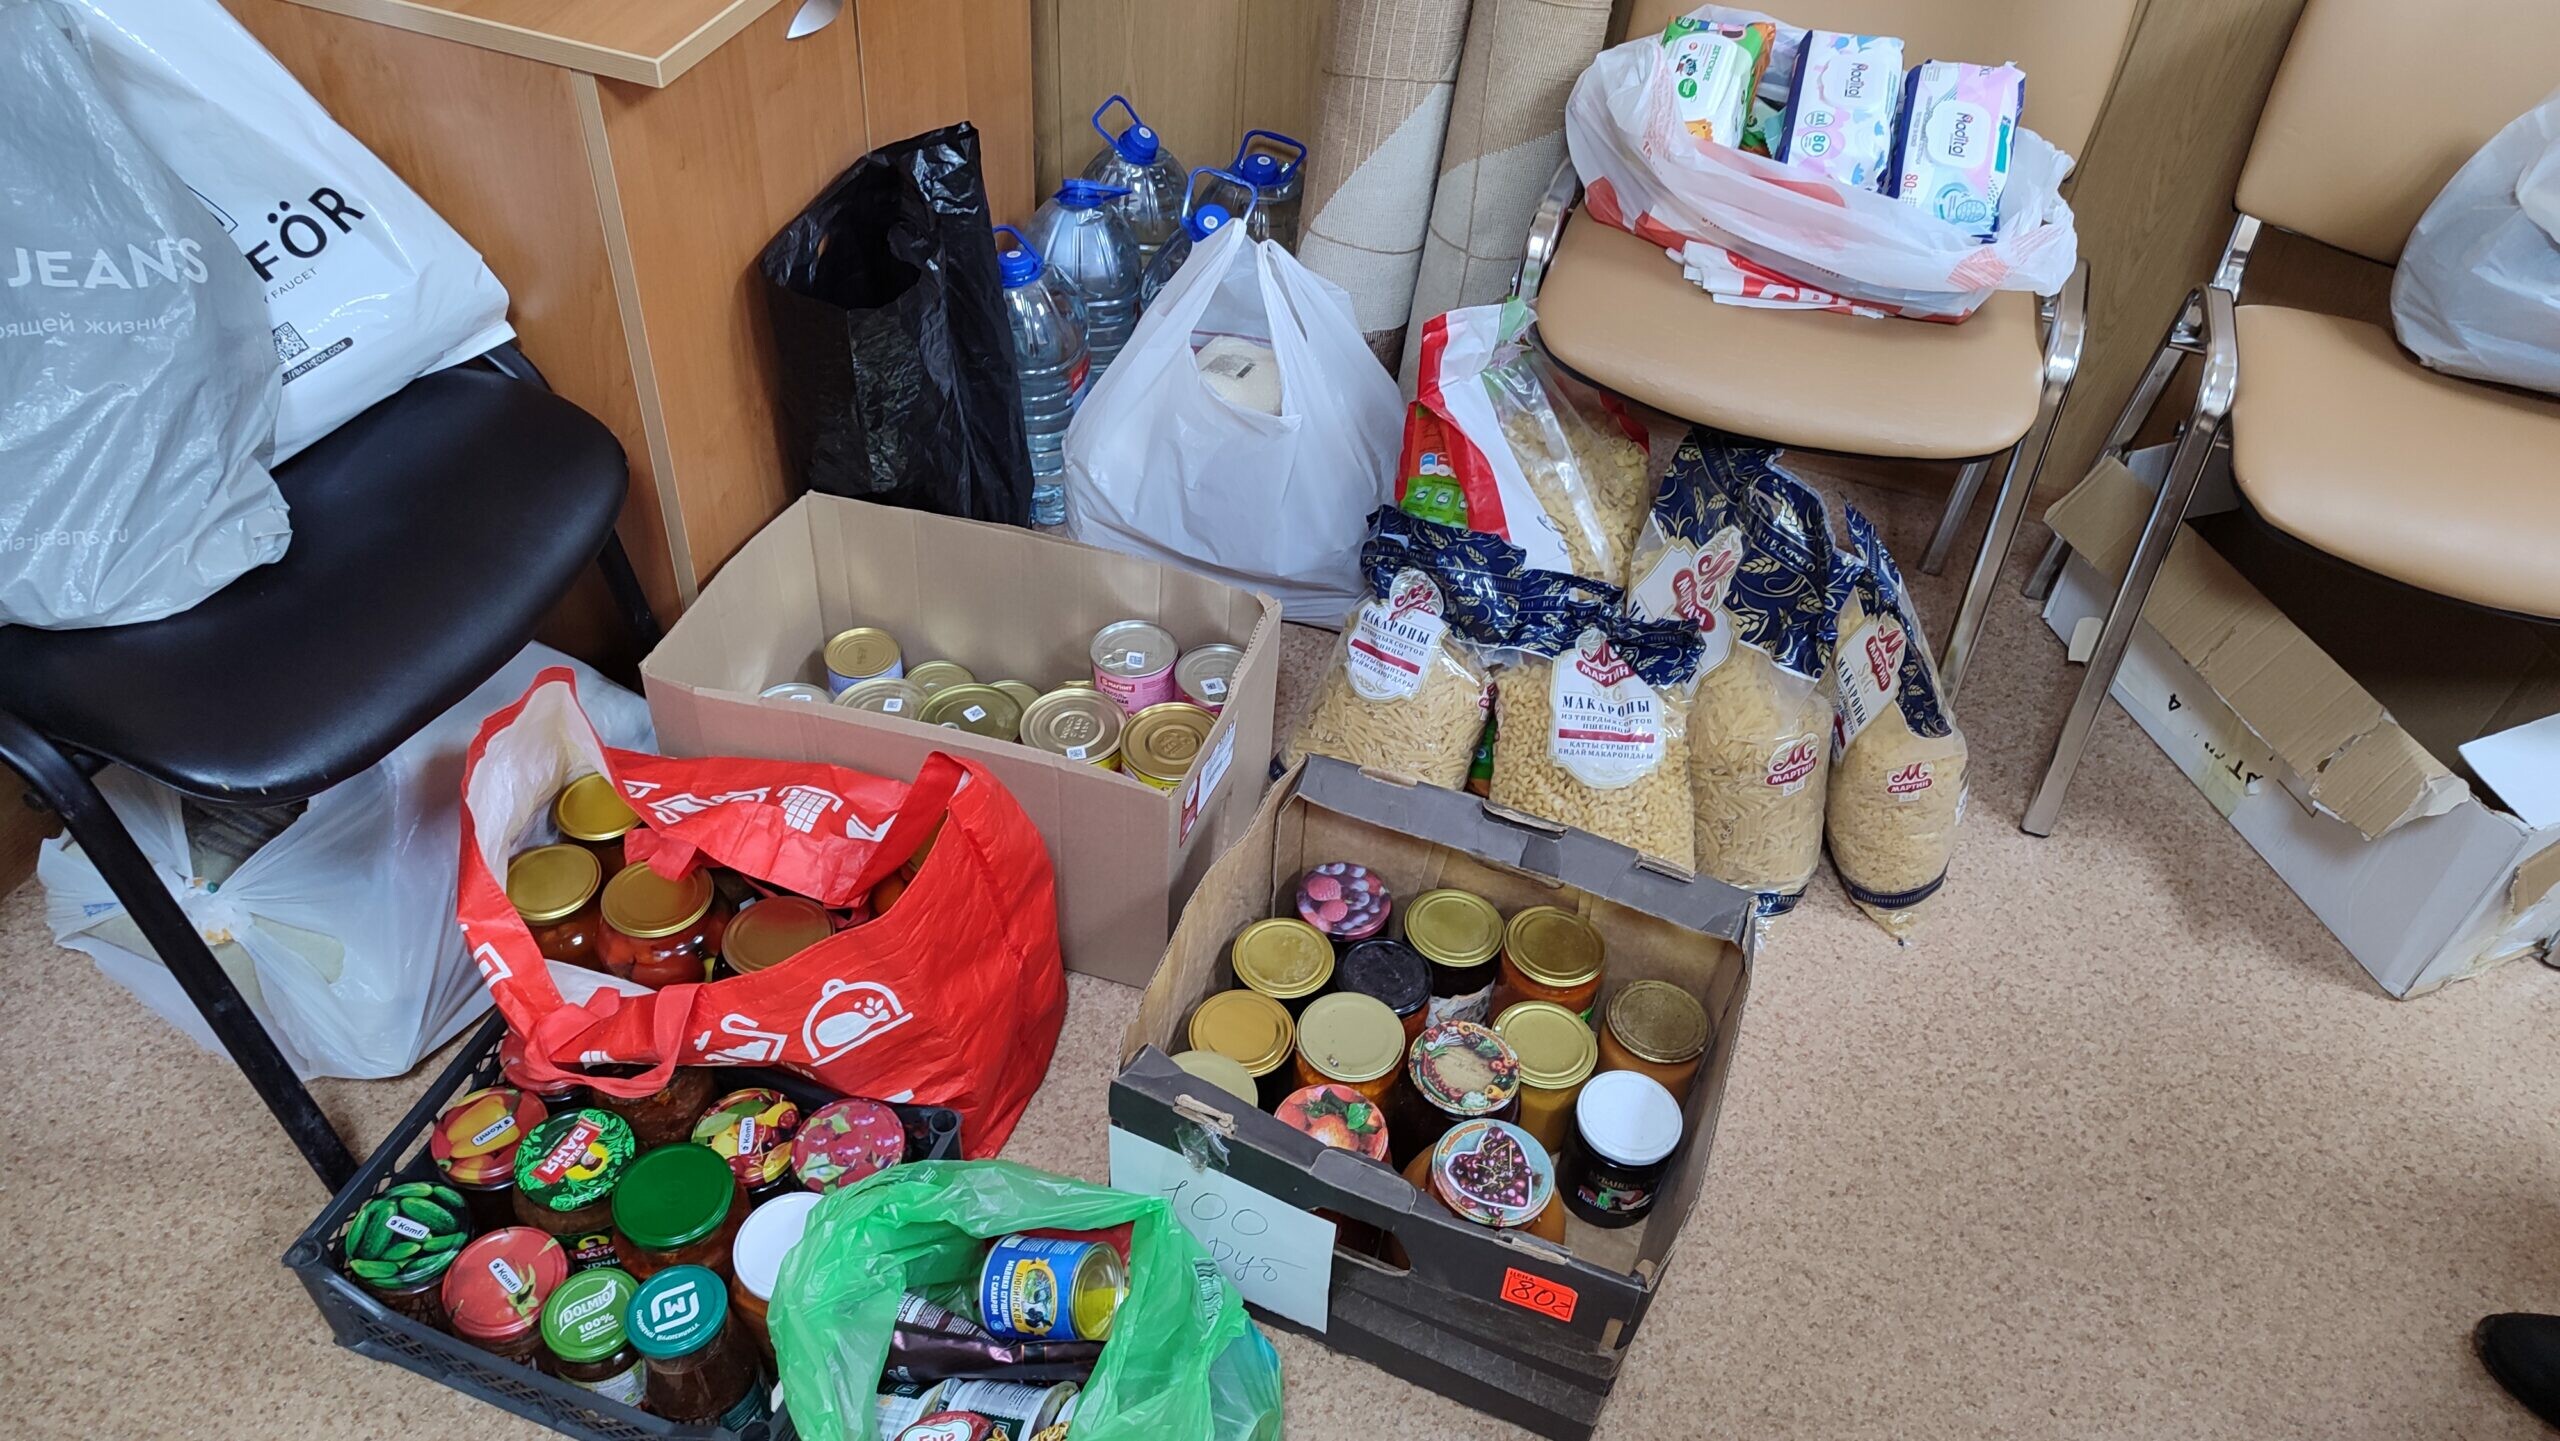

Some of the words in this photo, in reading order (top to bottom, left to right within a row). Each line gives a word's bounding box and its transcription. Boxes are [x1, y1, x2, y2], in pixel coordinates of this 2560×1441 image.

[1812, 135, 1826, 153] 80
[1903, 173, 1918, 189] 80
[8, 238, 208, 289] JEANS
[271, 267, 318, 299] FAUCET
[84, 317, 167, 335] жизни
[1581, 664, 1630, 683] МАРТИН
[1868, 641, 1890, 688] МАРТИН
[1837, 656, 1867, 727] МАКАРОНЫ
[1562, 695, 1650, 718] МАКАРОНЫ
[1771, 762, 1815, 784] МАРТИН
[1890, 780, 1930, 793] МАРТИН
[475, 1122, 503, 1143] Komfi
[743, 1118, 753, 1147] Komfi
[541, 1126, 590, 1175] ВАНЯ
[398, 1221, 425, 1238] Komfi
[497, 1267, 519, 1292] Komfi
[1002, 1260, 1015, 1289] МОЛОКО
[563, 1289, 612, 1322] DOLMIO
[990, 1282, 999, 1315] САХАРОМ
[578, 1313, 616, 1334] 100%
